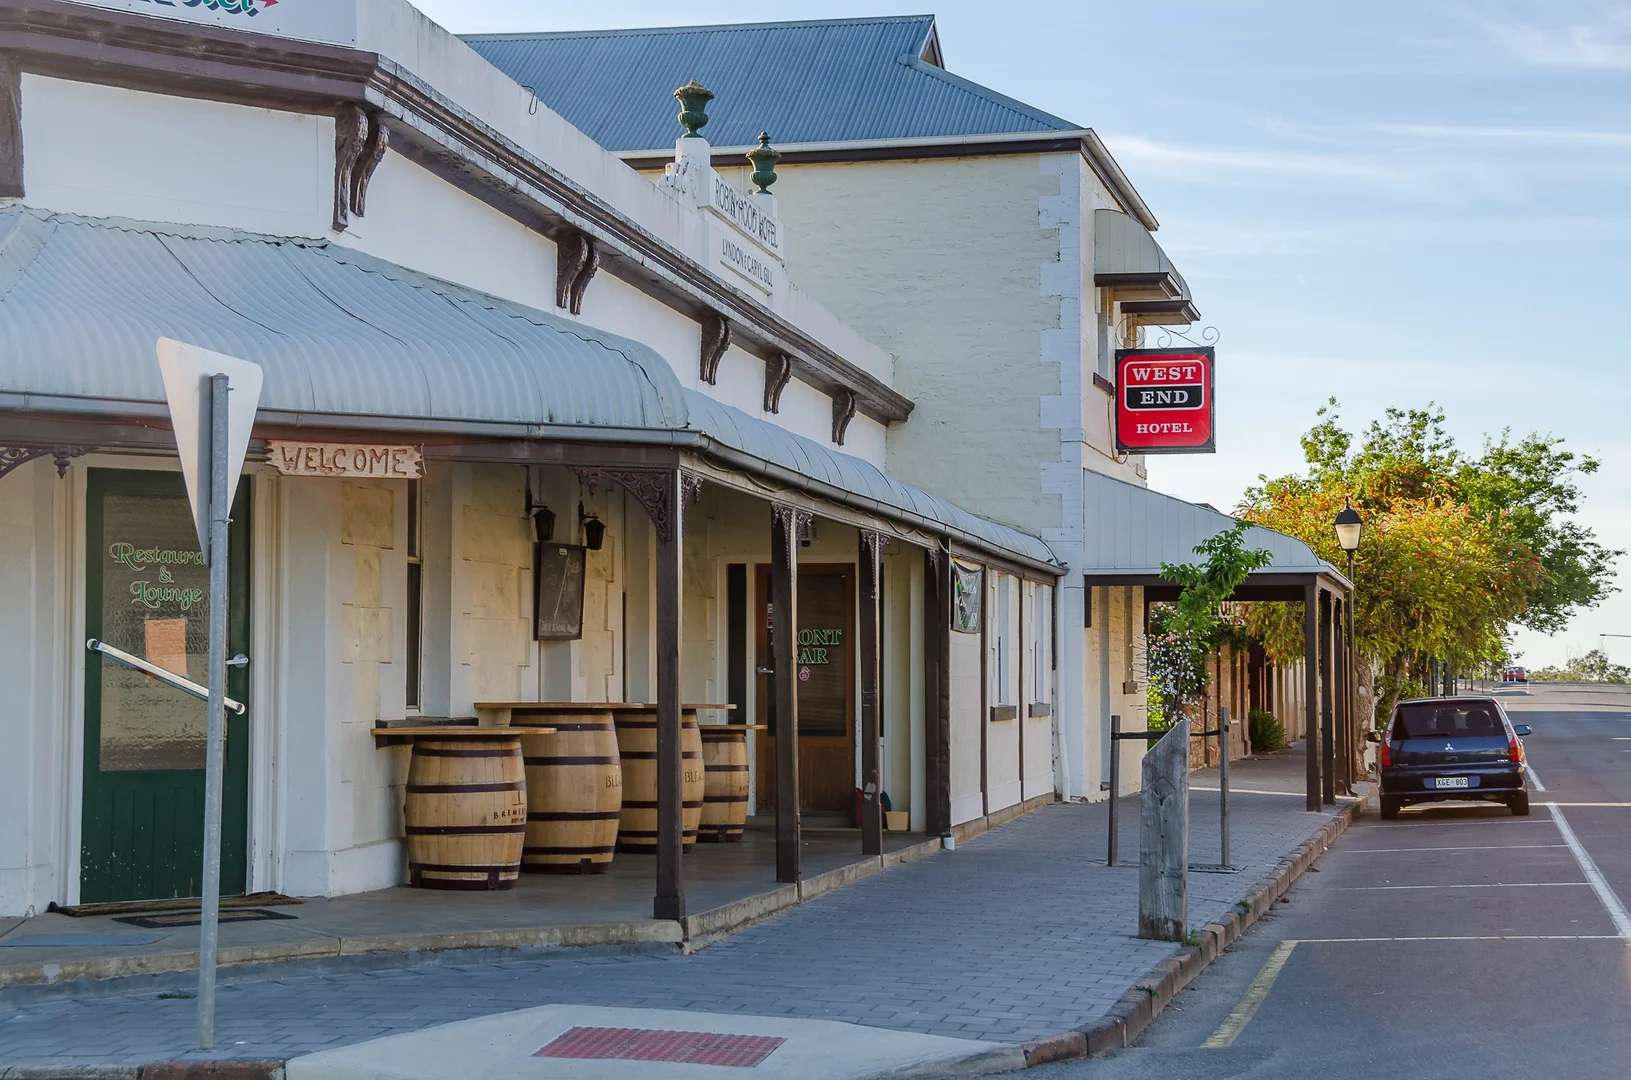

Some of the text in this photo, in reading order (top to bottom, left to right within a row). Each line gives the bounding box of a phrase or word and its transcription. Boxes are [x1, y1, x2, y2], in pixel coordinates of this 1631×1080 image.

[737, 198, 758, 233] HOOD
[758, 213, 779, 250] HOTEL
[722, 238, 744, 268] LYNDON
[763, 266, 774, 288] GILL
[1132, 366, 1196, 381] WEST
[1140, 390, 1189, 404] END
[1136, 422, 1193, 434] HOTEL
[280, 445, 407, 476] WELCOME
[158, 565, 175, 583] &
[129, 581, 202, 611] Lounge
